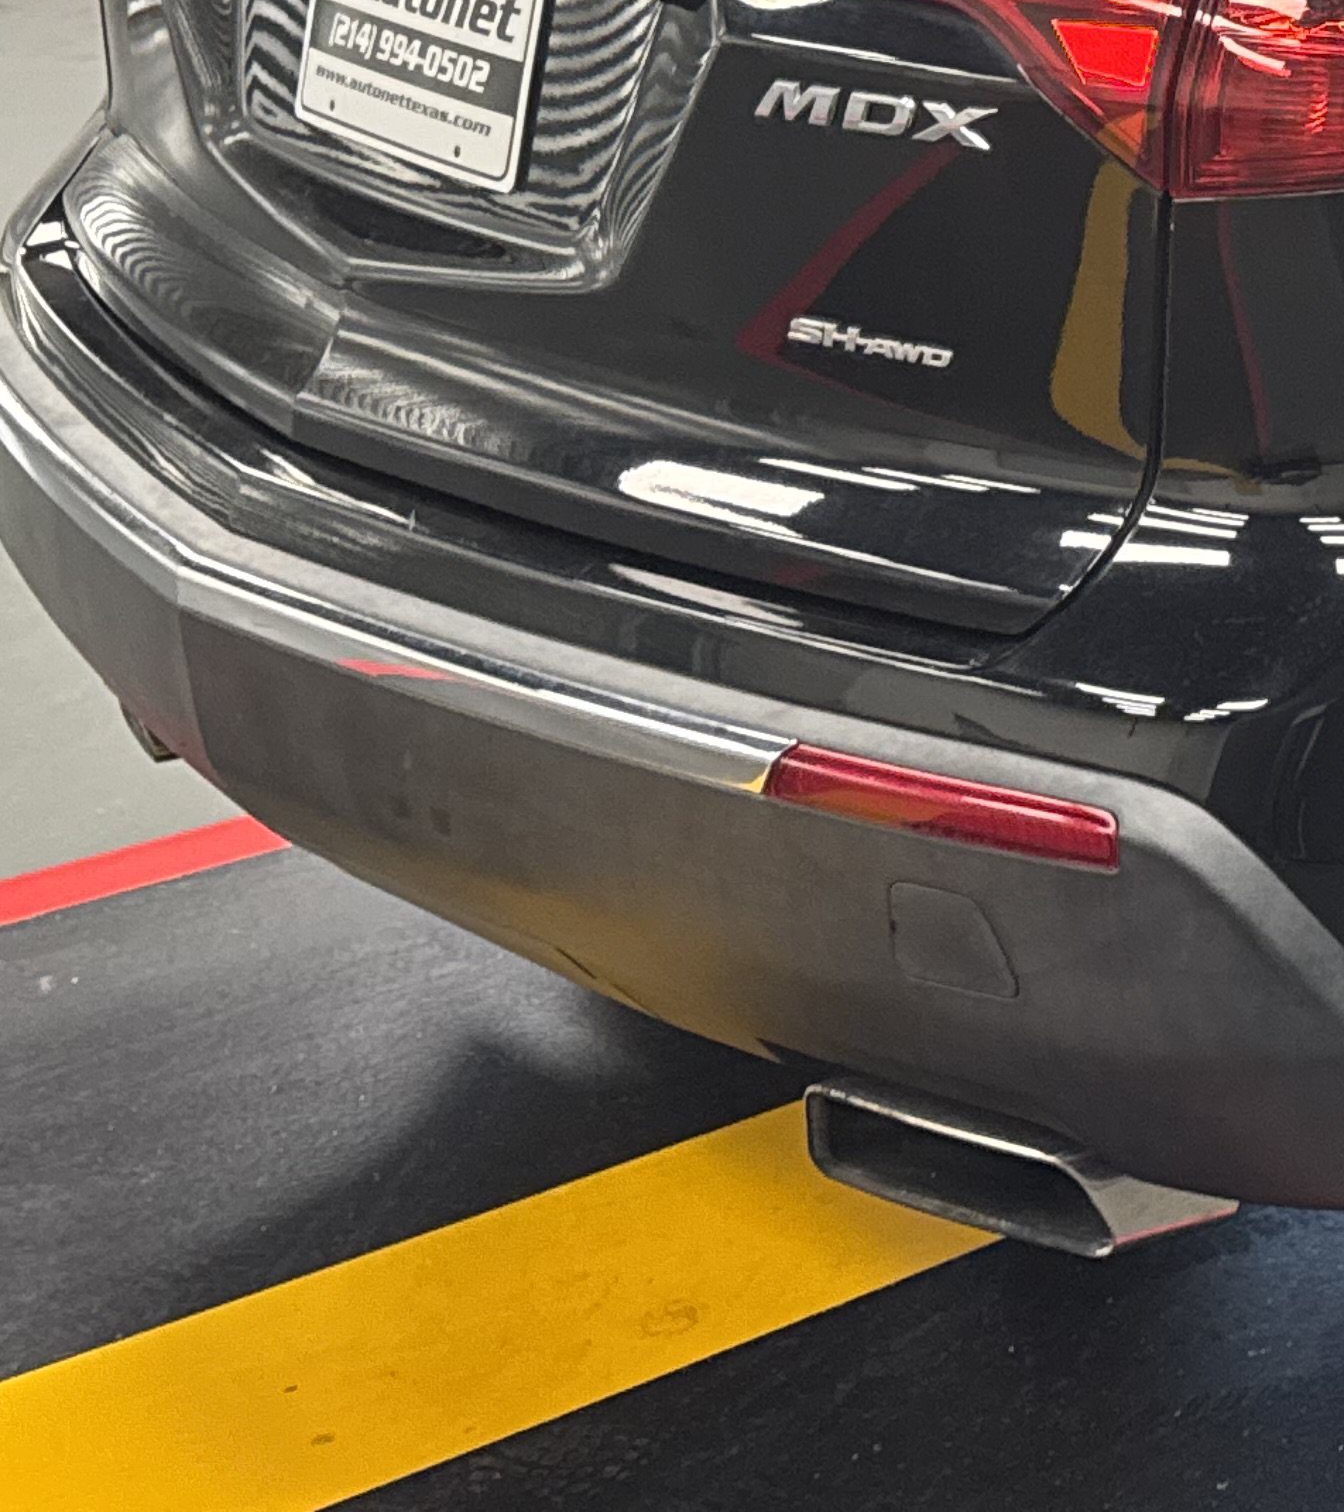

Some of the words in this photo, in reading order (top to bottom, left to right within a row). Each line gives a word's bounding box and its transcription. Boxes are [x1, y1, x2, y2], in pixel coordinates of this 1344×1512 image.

[328, 12, 377, 60] (214)
[375, 29, 491, 94] 994-0502
[315, 64, 492, 137] www.autonettexas.com
[755, 79, 998, 151] MDX
